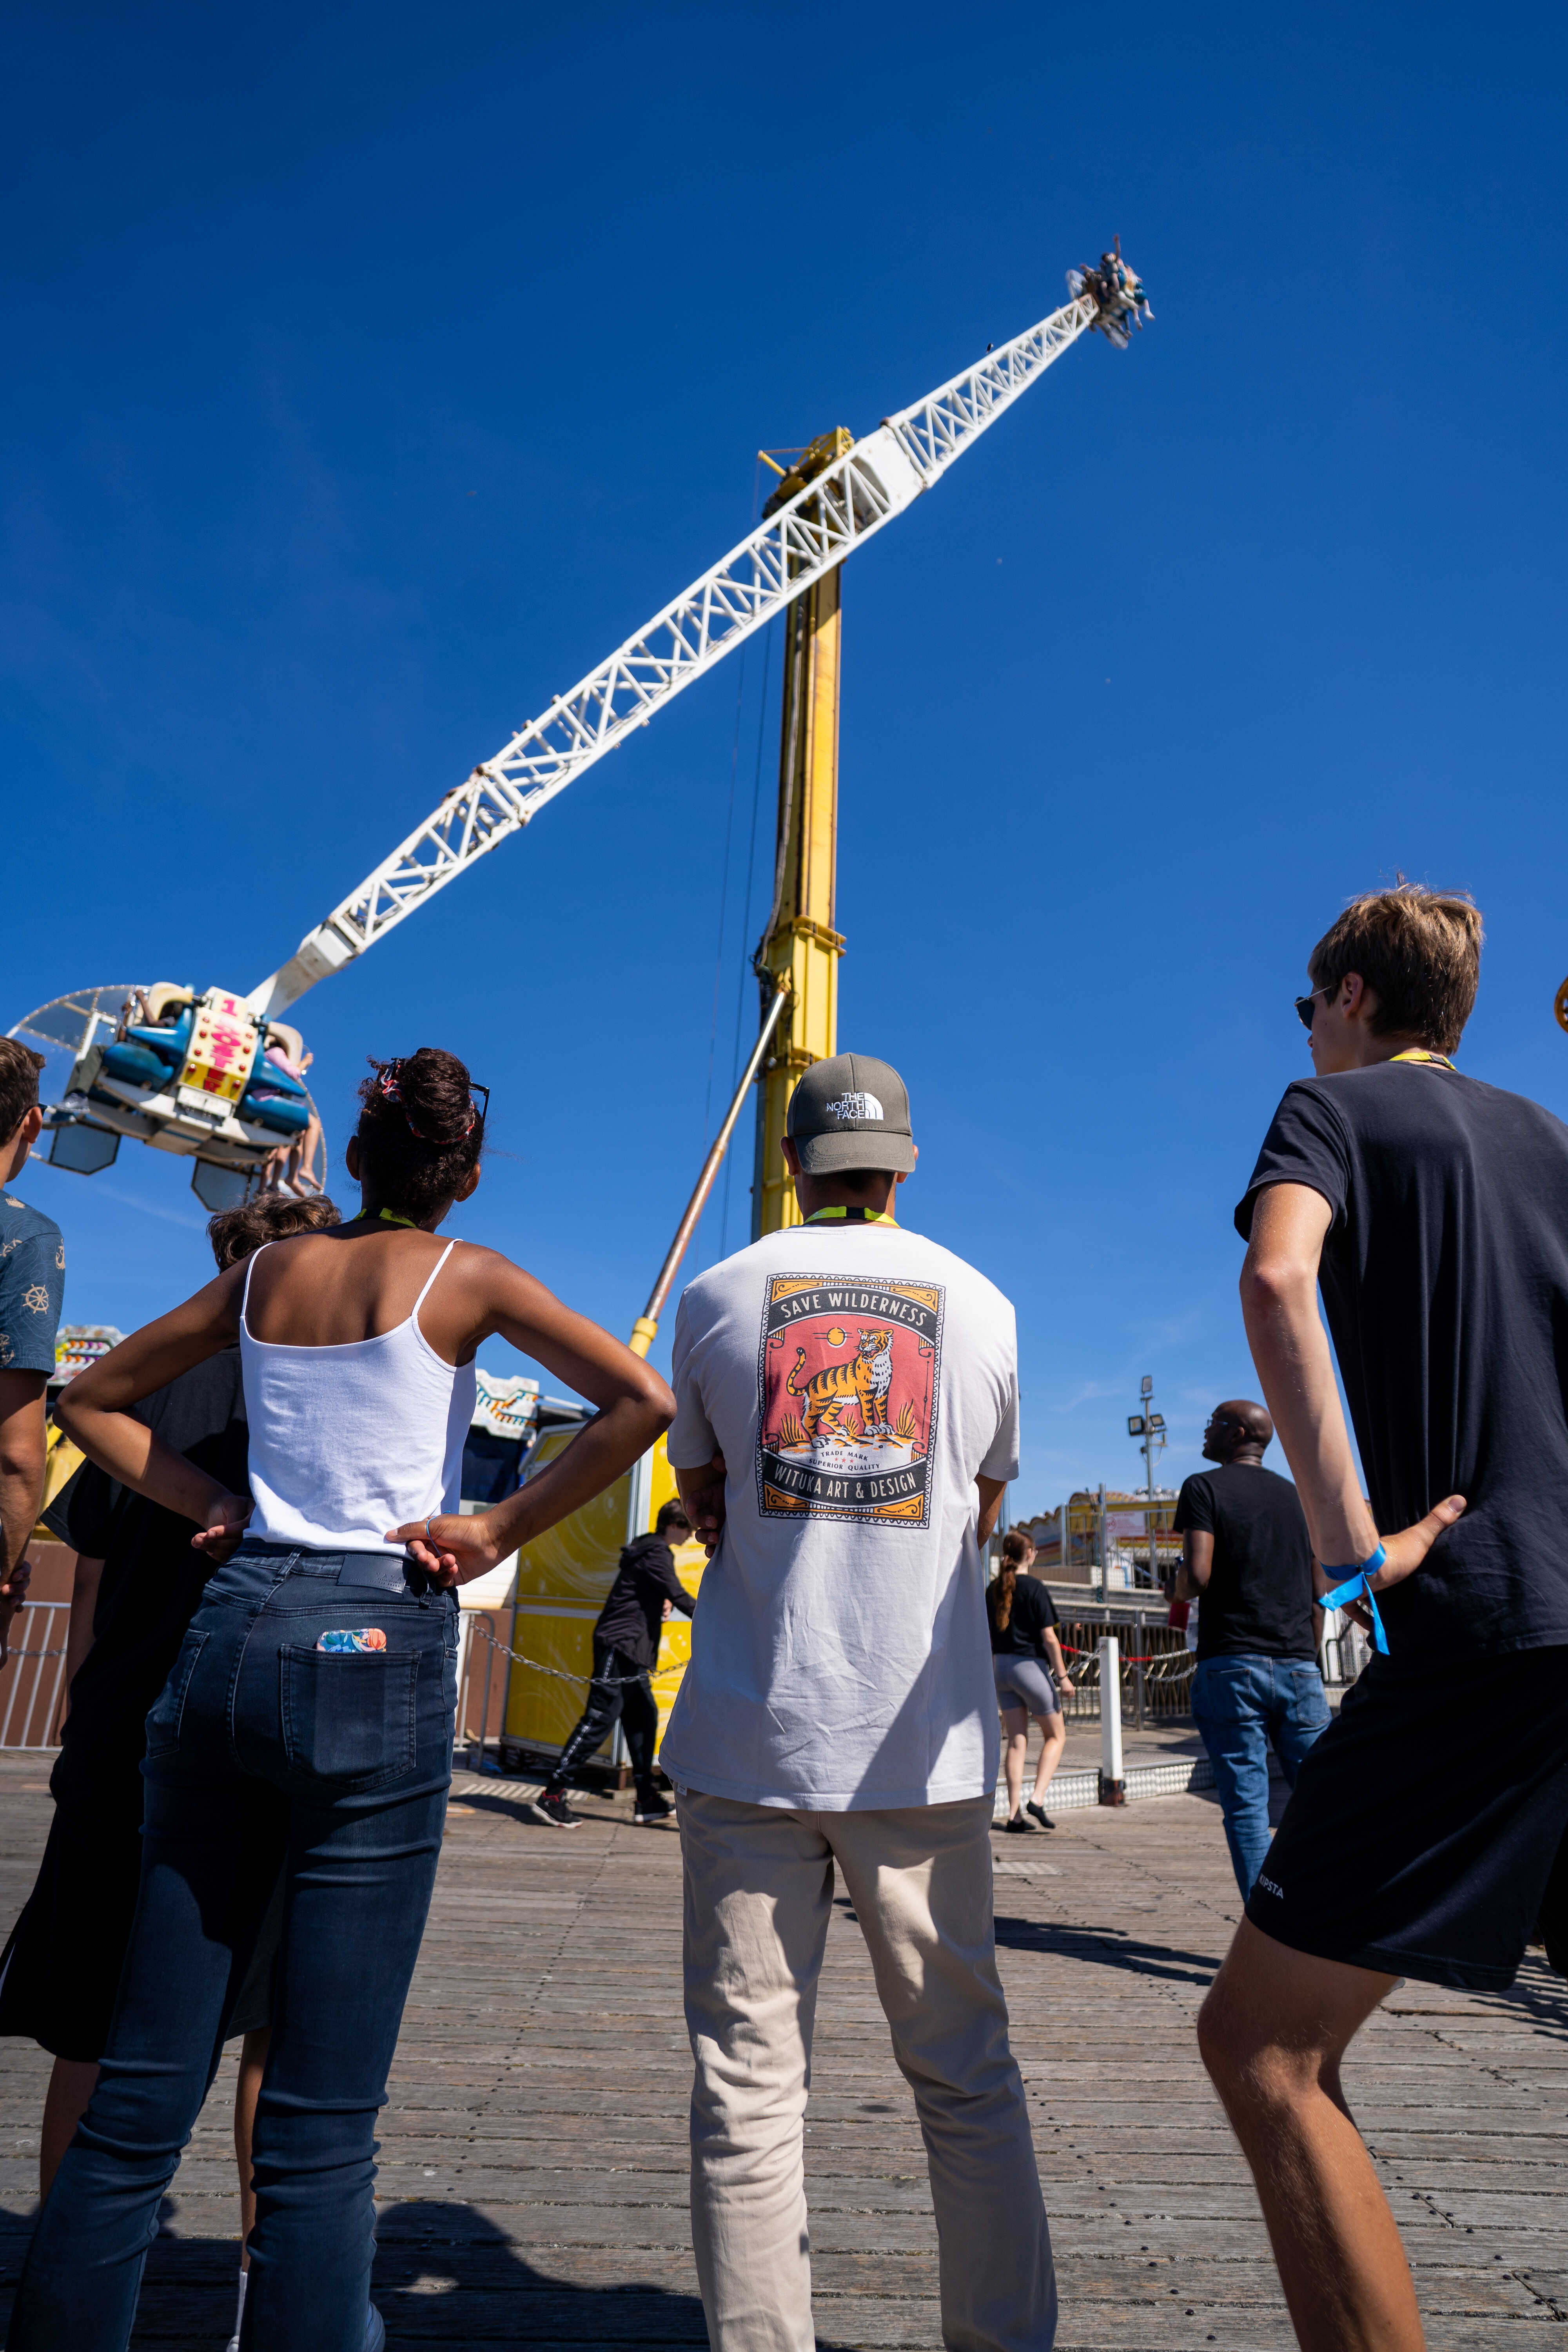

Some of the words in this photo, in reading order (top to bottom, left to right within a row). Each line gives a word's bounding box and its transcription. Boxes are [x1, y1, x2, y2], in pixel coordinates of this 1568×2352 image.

[842, 1092, 864, 1101] THE
[826, 1100, 865, 1112] NORTH
[837, 1109, 865, 1120] FACE
[780, 1294, 821, 1318] SAVE
[828, 1292, 927, 1326] WILDERNESS
[848, 1452, 868, 1461] MARK
[809, 1458, 843, 1469] SUPERIOR
[774, 1464, 821, 1494] WITUKA
[826, 1480, 849, 1498] ART
[856, 1482, 864, 1499] &
[870, 1472, 916, 1497] DESIGN
